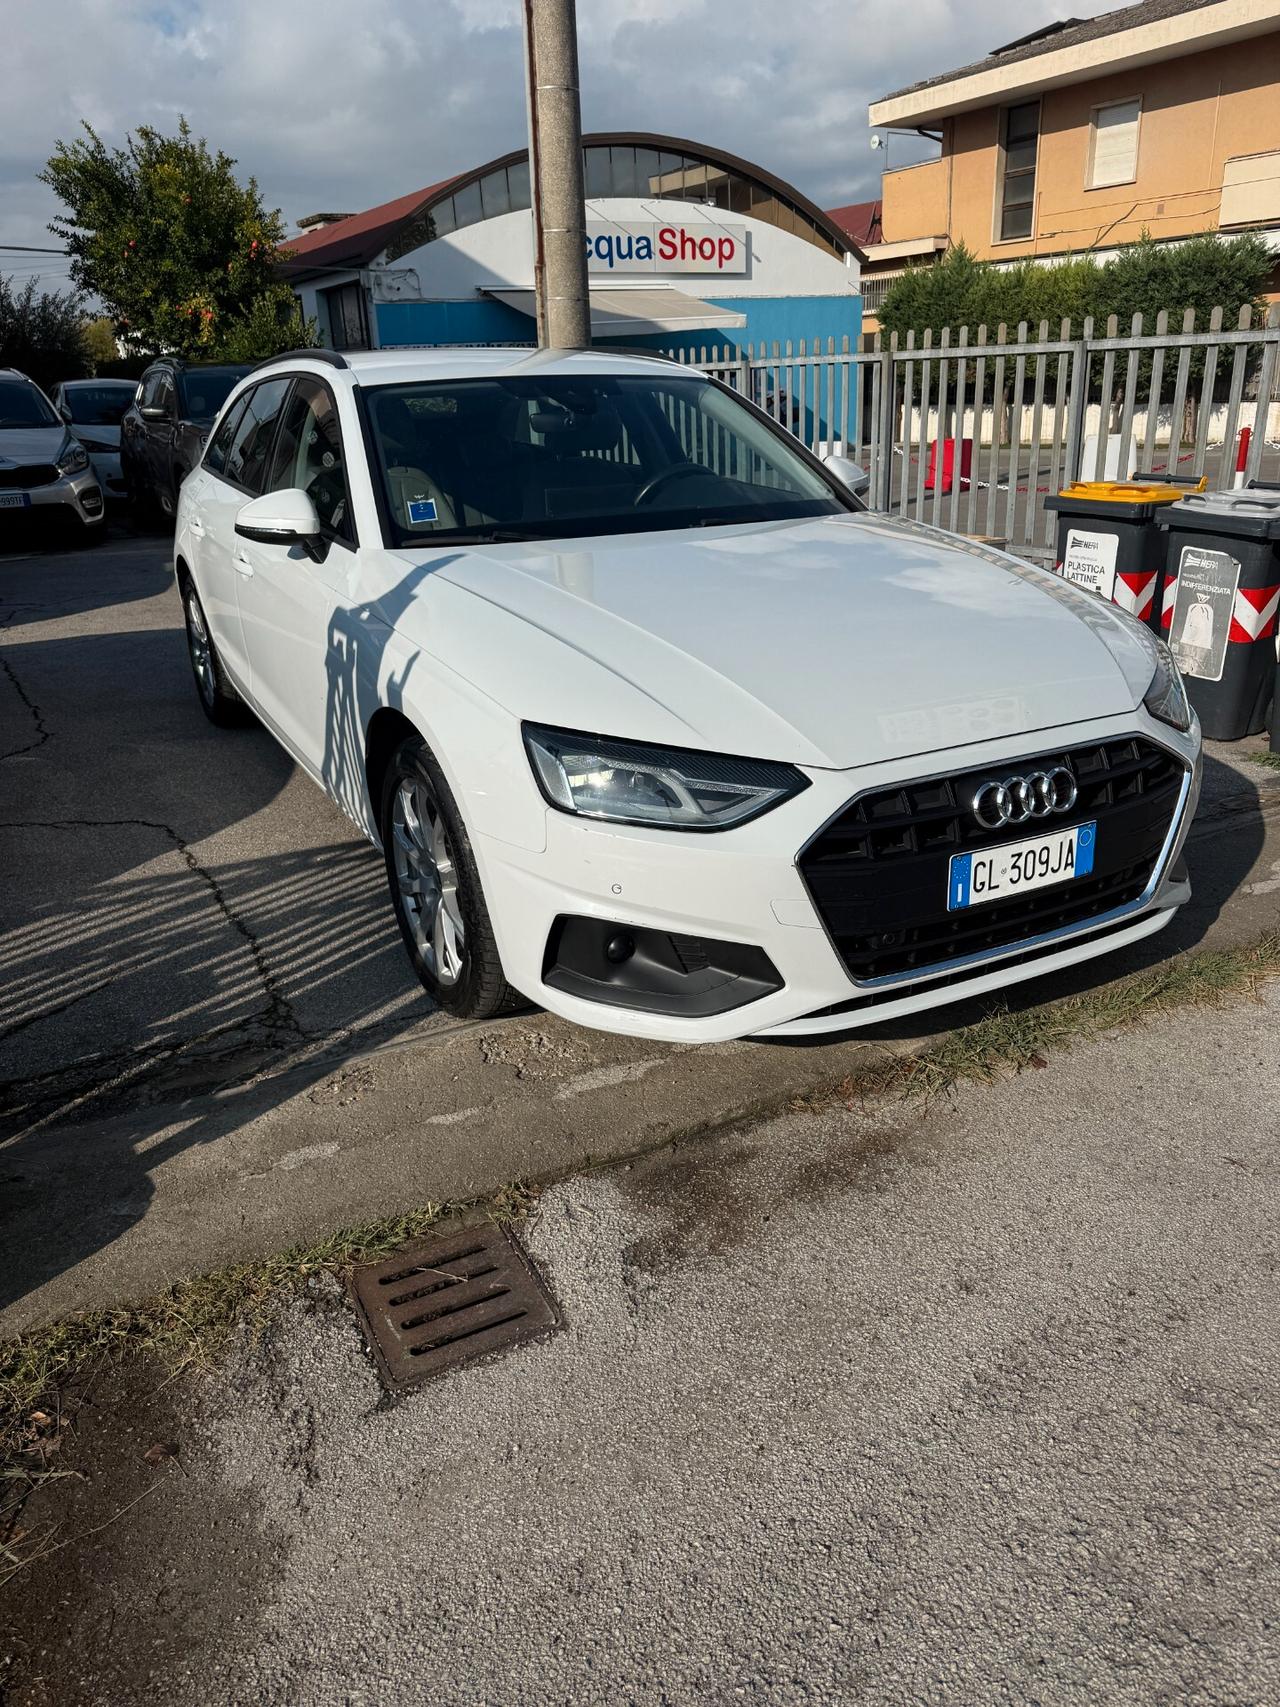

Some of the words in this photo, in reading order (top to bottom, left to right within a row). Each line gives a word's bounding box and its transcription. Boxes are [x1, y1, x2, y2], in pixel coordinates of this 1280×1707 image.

[584, 235, 652, 268] cqua
[658, 228, 735, 268] Shop
[1067, 560, 1105, 575] PLASTICA
[1066, 571, 1098, 584] LATTINE
[1181, 580, 1231, 595] INDIFFERENZIATA
[973, 859, 1000, 893] GL
[1009, 838, 1075, 885] 309JA
